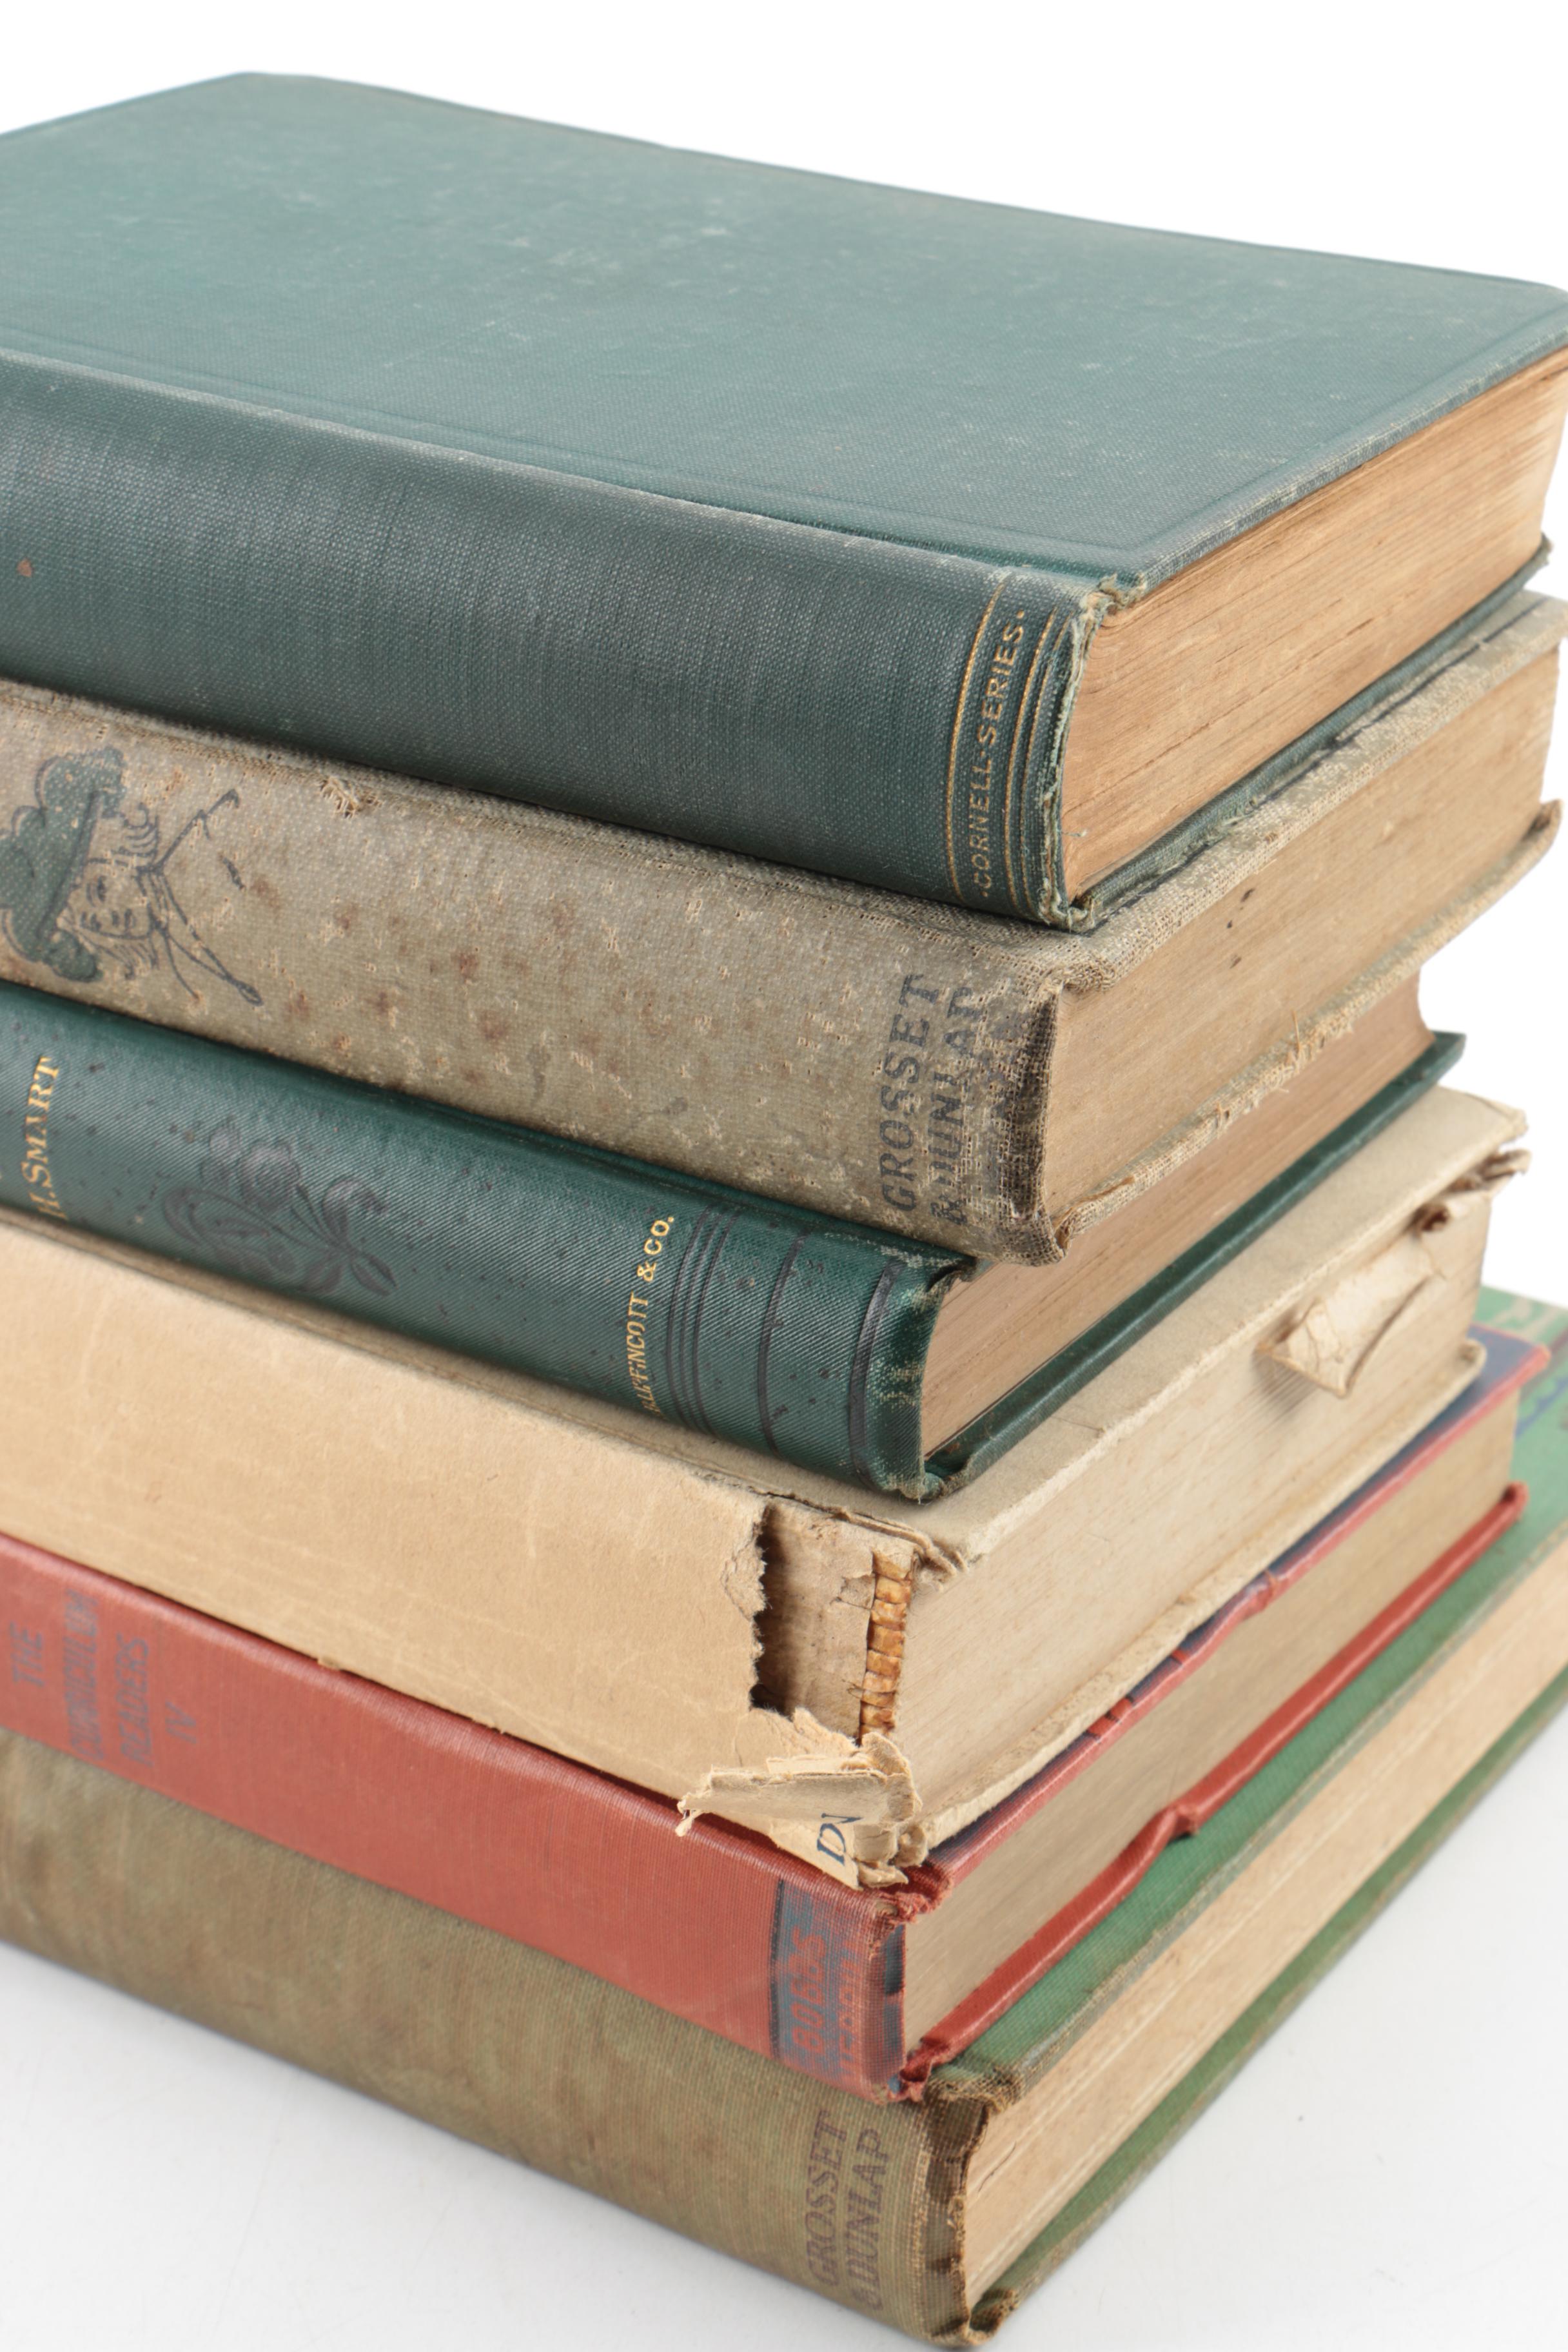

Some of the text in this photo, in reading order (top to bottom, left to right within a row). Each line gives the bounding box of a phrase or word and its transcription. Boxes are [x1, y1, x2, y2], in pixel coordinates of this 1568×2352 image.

[879, 974, 939, 1211] GROSSET
[636, 1260, 658, 1282] &
[643, 1216, 674, 1255] CO.
[8, 1621, 44, 1687] THE
[114, 1632, 155, 1767] READERS
[164, 1700, 197, 1744] IV
[805, 2110, 847, 2286] GROSSET
[847, 2128, 889, 2289] DUNLAP
